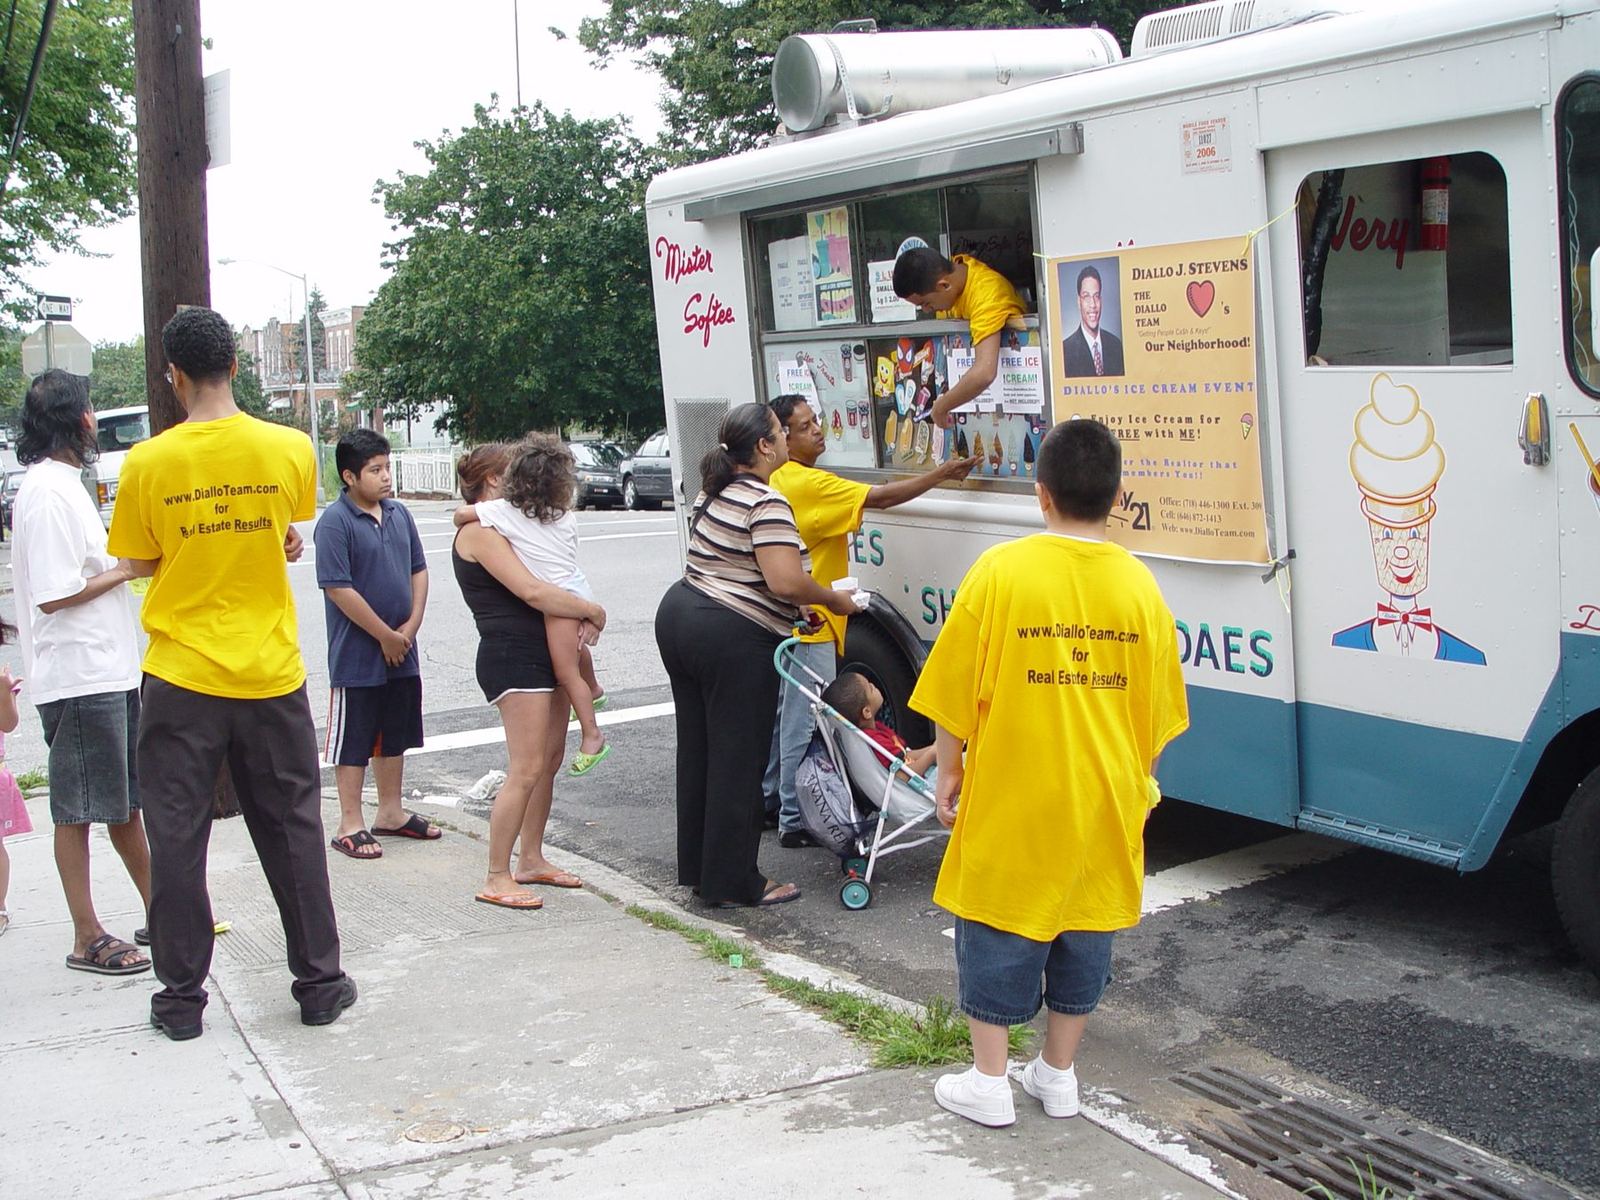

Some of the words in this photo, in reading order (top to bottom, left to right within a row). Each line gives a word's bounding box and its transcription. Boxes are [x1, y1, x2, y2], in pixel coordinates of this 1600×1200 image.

[1196, 147, 1216, 158] 2006
[656, 236, 713, 284] Mister
[1132, 267, 1173, 280] DIALLO
[1176, 263, 1186, 277] J.
[1189, 259, 1248, 275] STEVENS
[1134, 291, 1151, 301] THE
[1135, 303, 1167, 314] DIALLO
[684, 293, 735, 348] Softee
[1136, 318, 1160, 327] TEAM
[1145, 341, 1164, 352] Our
[1168, 337, 1251, 353] Neighborhood!
[1001, 357, 1022, 367] FREE
[1025, 356, 1039, 366] ICE
[787, 368, 802, 377] FREE
[1064, 385, 1120, 396] DIALLO'S
[1124, 384, 1145, 395] ICE
[1152, 383, 1197, 394] CREAM
[1204, 382, 1253, 393] EVENT
[1129, 414, 1147, 424] Ice
[1154, 414, 1193, 424] Cream
[1200, 414, 1221, 424] for
[1145, 428, 1174, 438] with
[1180, 429, 1201, 440] ME!
[1210, 461, 1238, 469] that
[163, 485, 279, 506] www.DialloTeam.com
[214, 503, 229, 515] for
[1159, 496, 1181, 506] Office:
[1232, 501, 1249, 510] Ext.
[1130, 502, 1151, 530] 21
[1160, 509, 1176, 519] Cell:
[198, 519, 231, 534] Estate
[234, 516, 272, 532] Results
[1161, 523, 1179, 532] Web:
[1180, 527, 1255, 538] www.DialloTeam.com
[848, 527, 885, 567] ES
[1072, 646, 1089, 663] for
[1027, 669, 1055, 685] Real
[1091, 671, 1128, 690] Results
